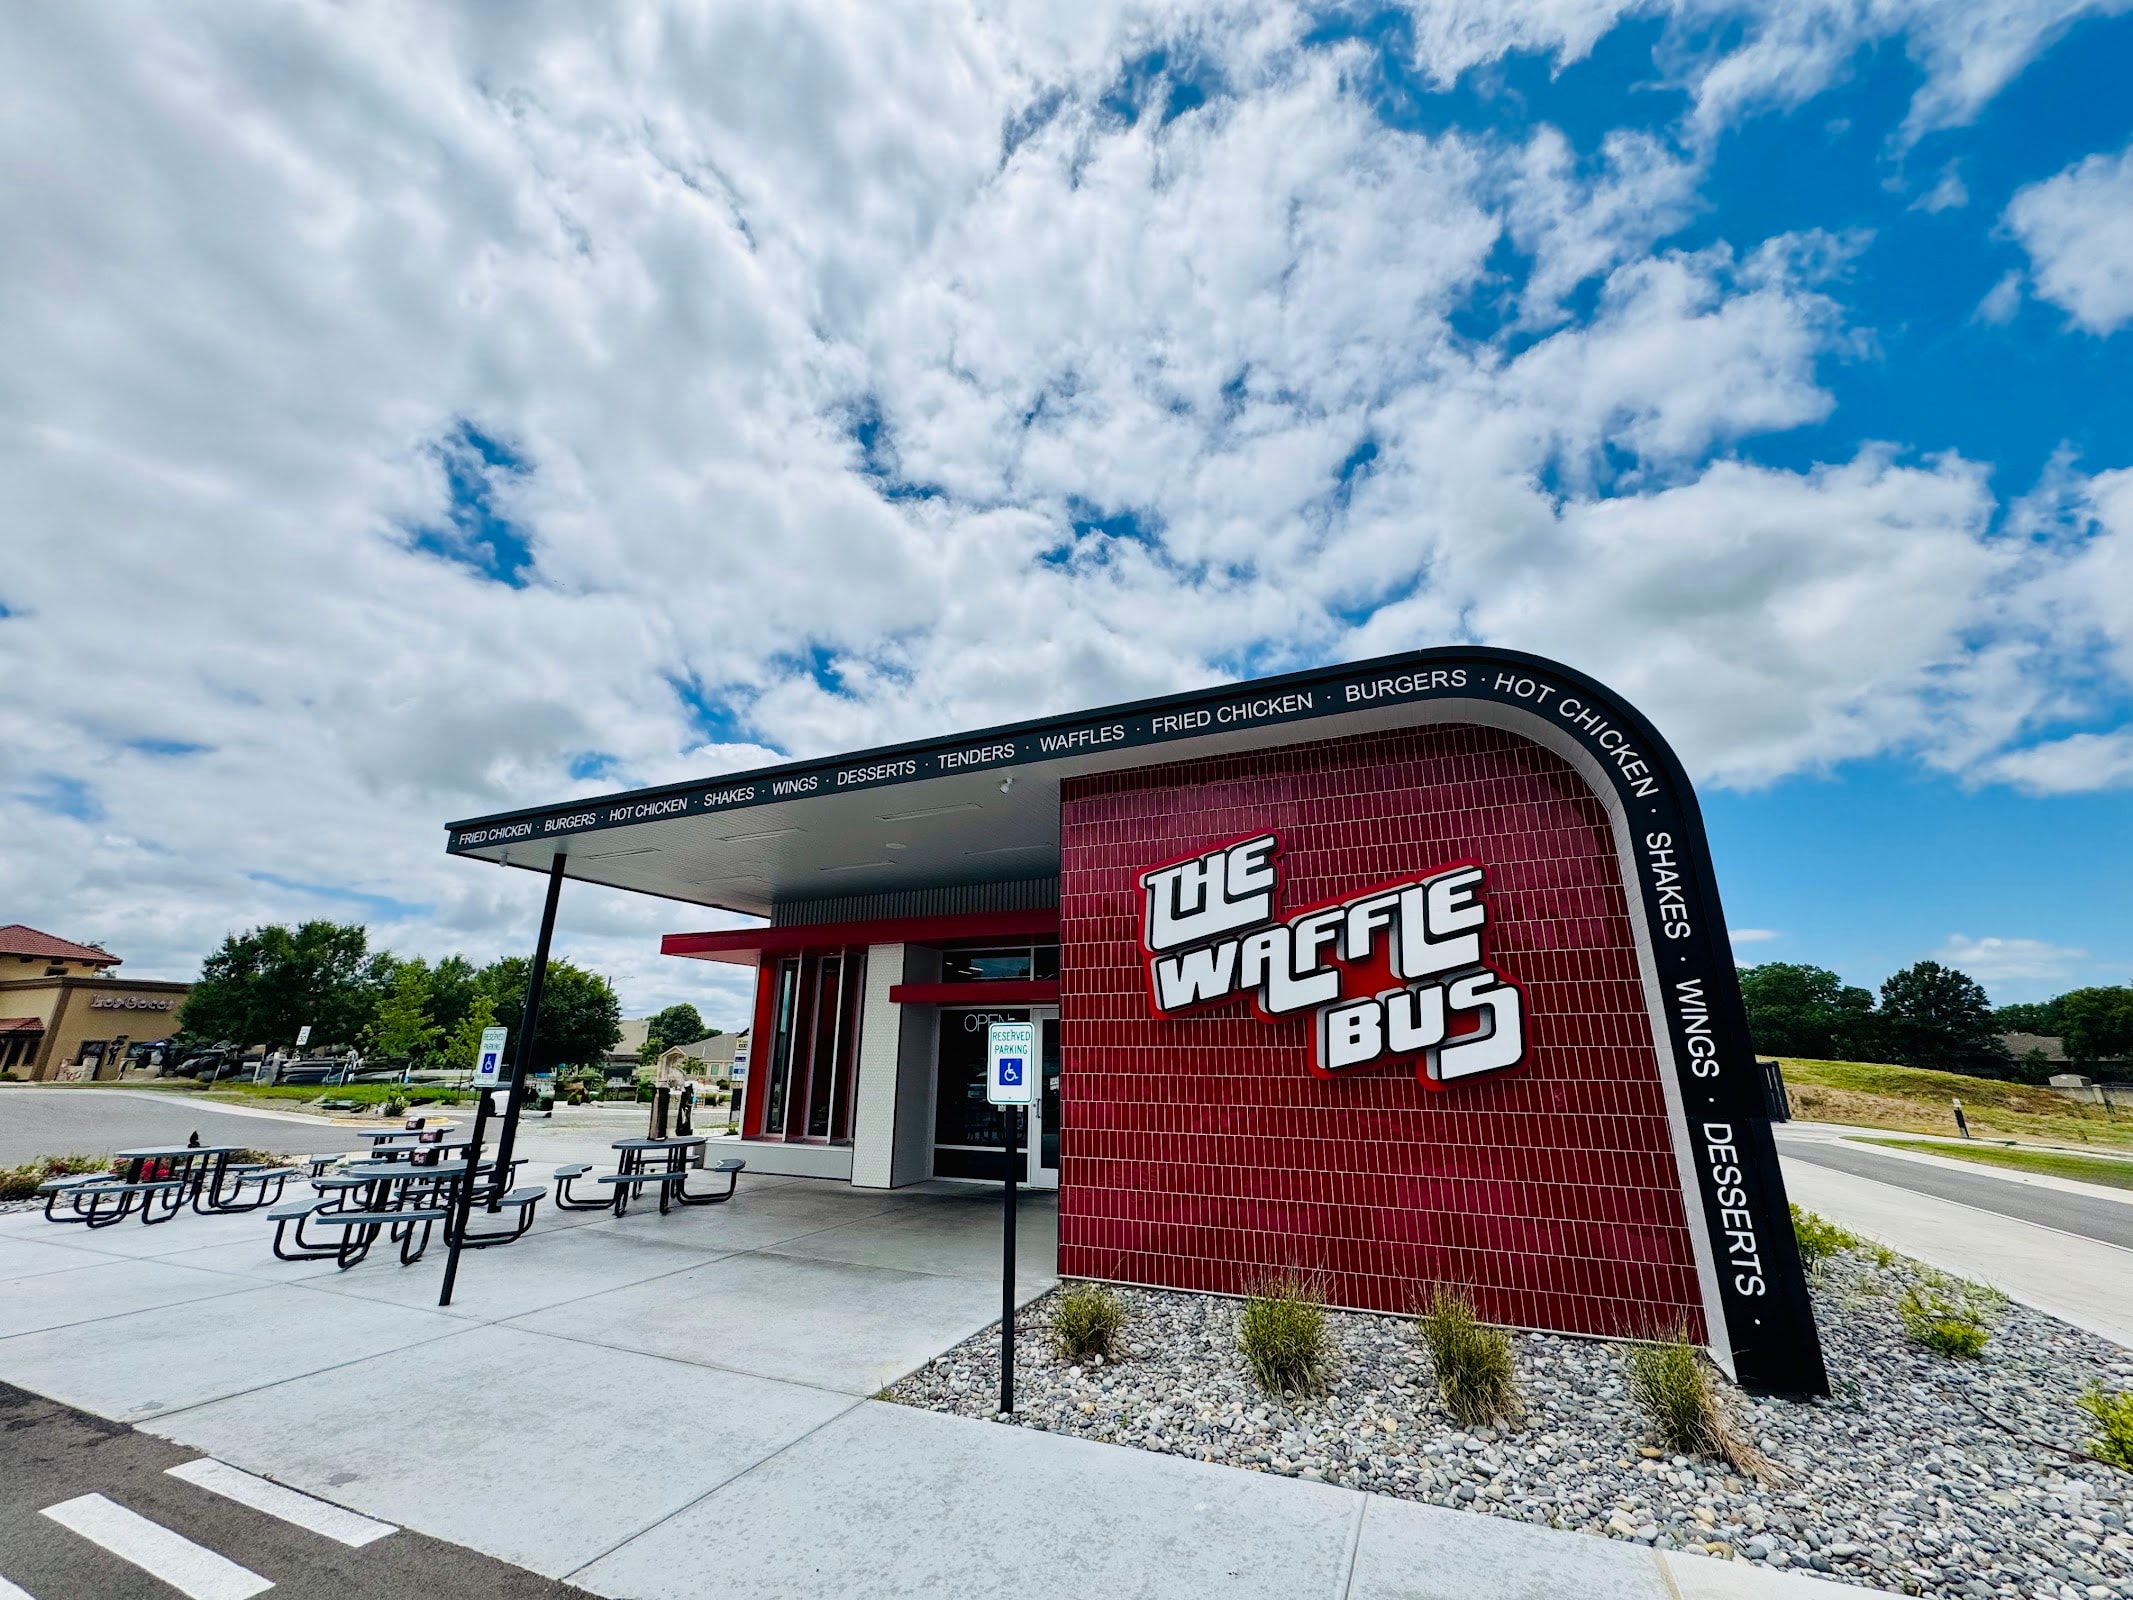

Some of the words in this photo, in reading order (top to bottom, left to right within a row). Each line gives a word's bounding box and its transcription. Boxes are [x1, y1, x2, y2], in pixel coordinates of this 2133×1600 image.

[1145, 834, 1275, 951] THE
[1157, 868, 1486, 1014] WAFFLE
[458, 830, 487, 845] FRIED
[488, 823, 532, 840] CHICKEN
[544, 812, 597, 831] BURGERS
[609, 806, 634, 822] HOT
[635, 797, 688, 817] CHICKEN
[703, 786, 755, 806] SHAKES
[772, 776, 818, 796] WINGS
[837, 759, 916, 786] DESSERTS
[937, 743, 1015, 769] TENDERS
[1039, 724, 1125, 752] WAFFLES
[1151, 709, 1211, 734] FRIED
[1216, 692, 1313, 723] CHICKEN
[1345, 669, 1467, 702] BURGERS
[1493, 672, 1556, 704] HOT
[1558, 698, 1659, 799] CHICKEN
[1646, 832, 1691, 939] SHAKES
[1675, 978, 1720, 1077] WINGS
[1702, 1122, 1766, 1297] DESSERTS
[993, 1032, 1030, 1041] RESERVED
[1328, 972, 1523, 1081] BUS
[995, 1045, 1028, 1054] PARKING
